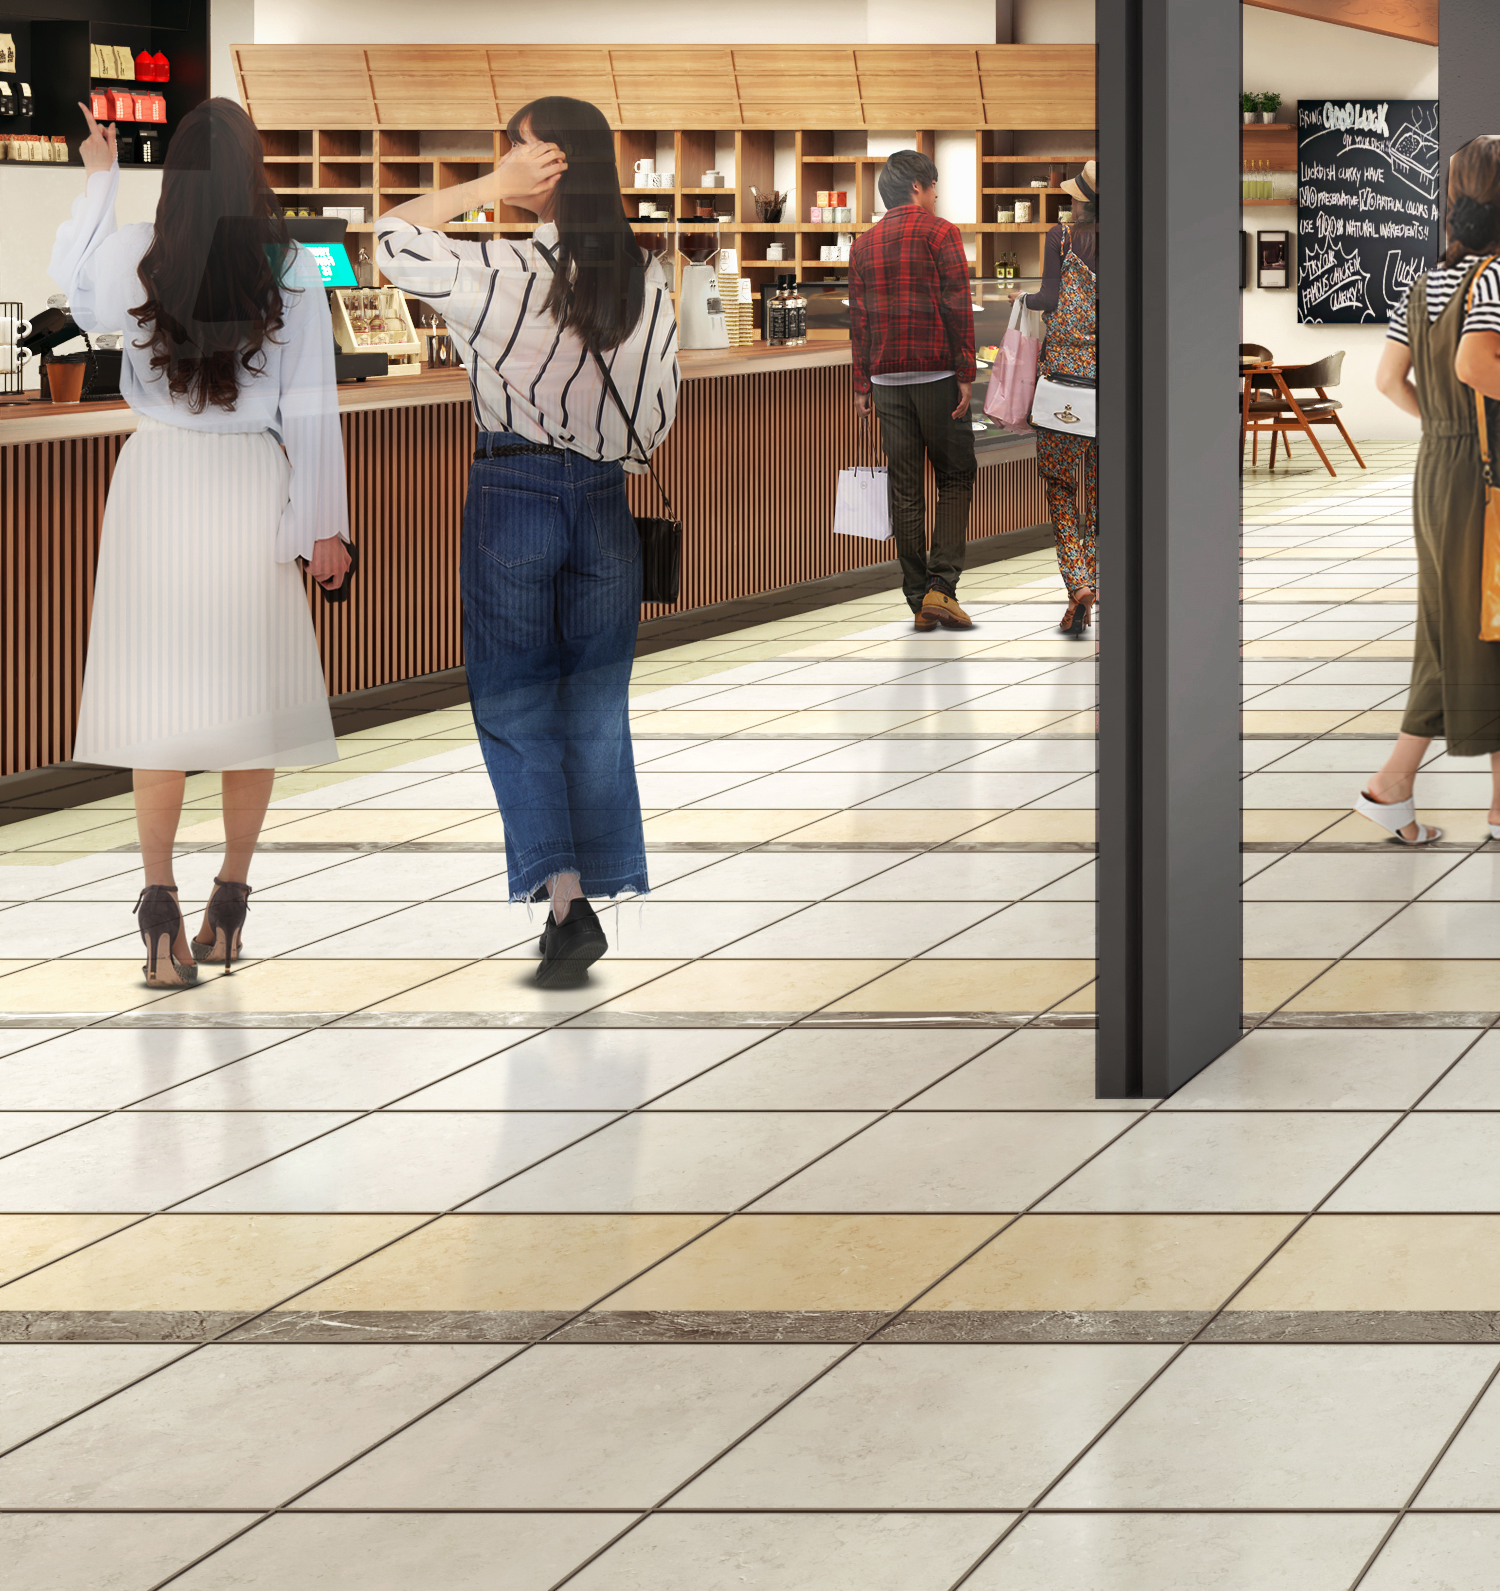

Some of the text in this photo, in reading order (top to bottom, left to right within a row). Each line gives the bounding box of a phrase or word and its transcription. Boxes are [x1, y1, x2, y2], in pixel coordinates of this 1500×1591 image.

[1299, 102, 1389, 137] BRING GOOD LUCK
[1343, 133, 1352, 151] ON
[1364, 167, 1384, 183] HAVE
[1299, 185, 1317, 209] NO
[1359, 187, 1376, 212] NO
[1406, 200, 1428, 219] COLORS
[1300, 219, 1314, 235] USE
[1346, 219, 1379, 238] NATURAL
[1330, 256, 1360, 285] CHICKEN
